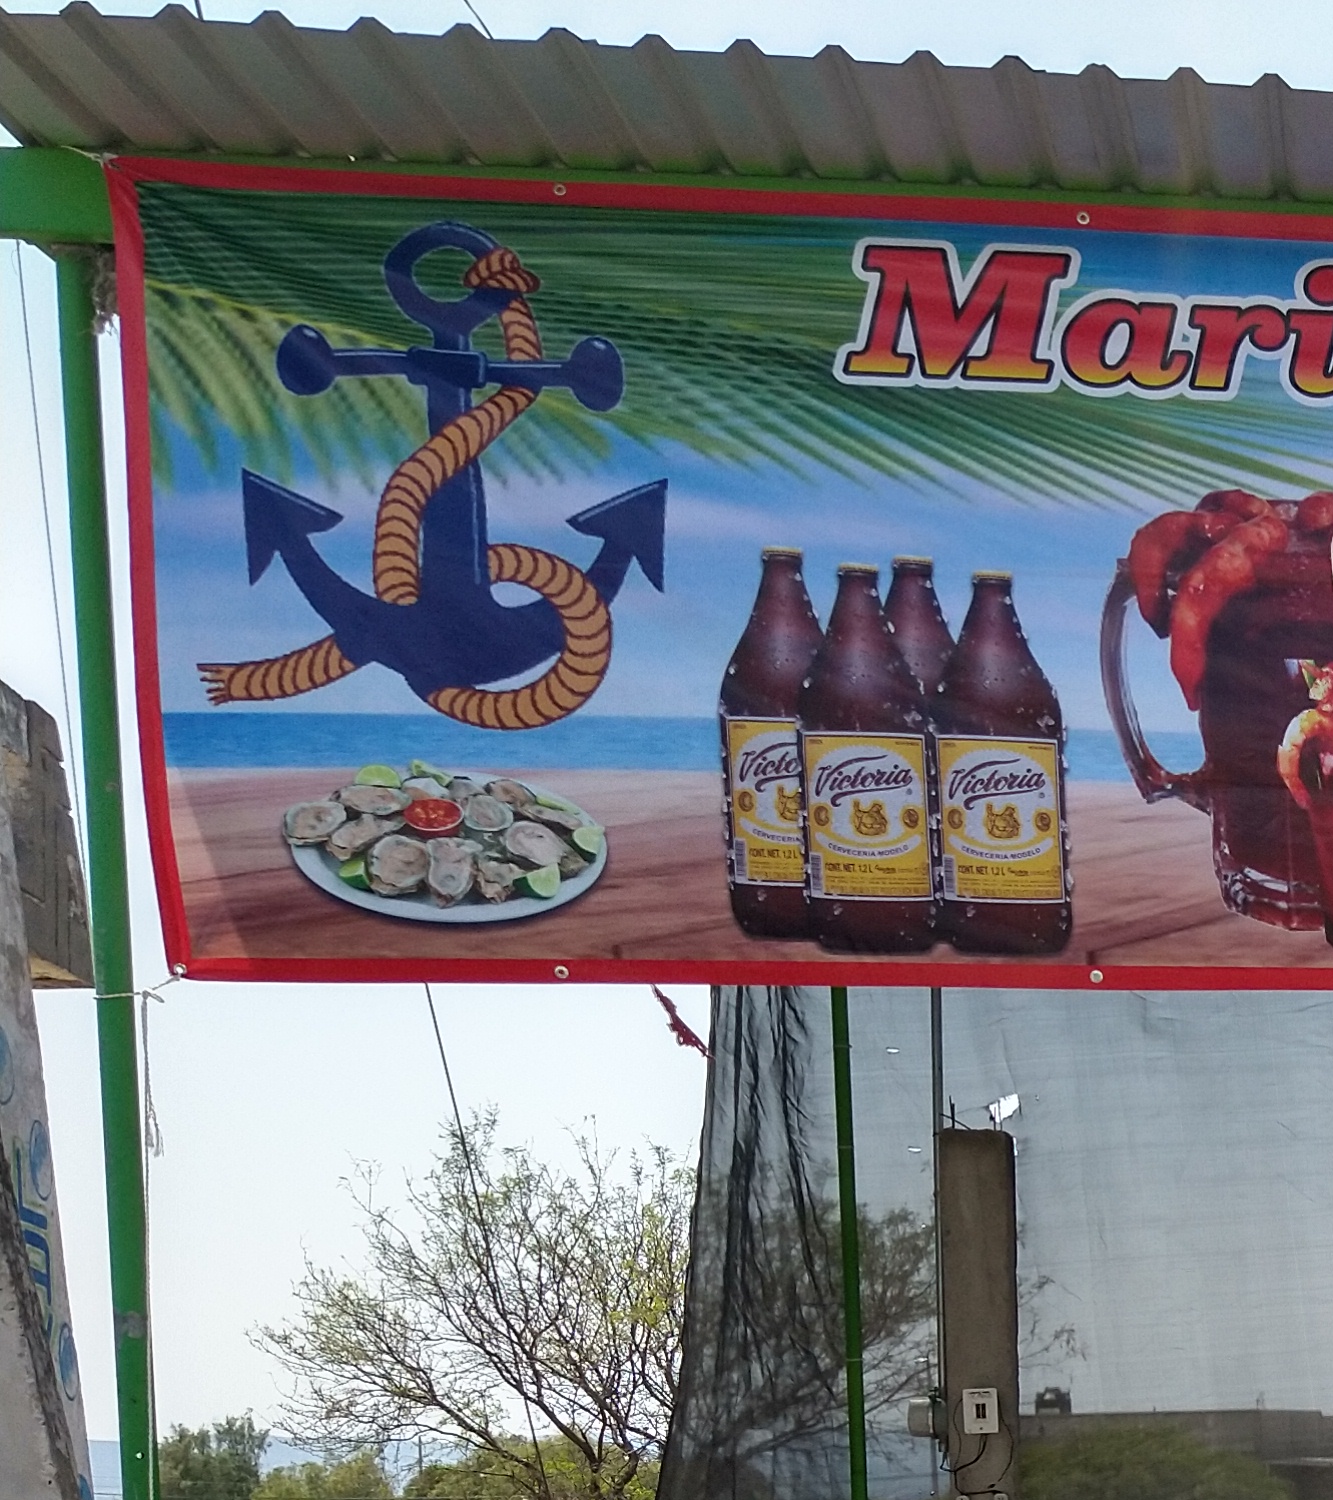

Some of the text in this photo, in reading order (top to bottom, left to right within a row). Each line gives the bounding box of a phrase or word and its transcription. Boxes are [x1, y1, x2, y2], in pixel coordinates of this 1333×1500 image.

[739, 742, 799, 793] Victo
[815, 755, 913, 807] Victoria
[948, 758, 1046, 810] Victoria
